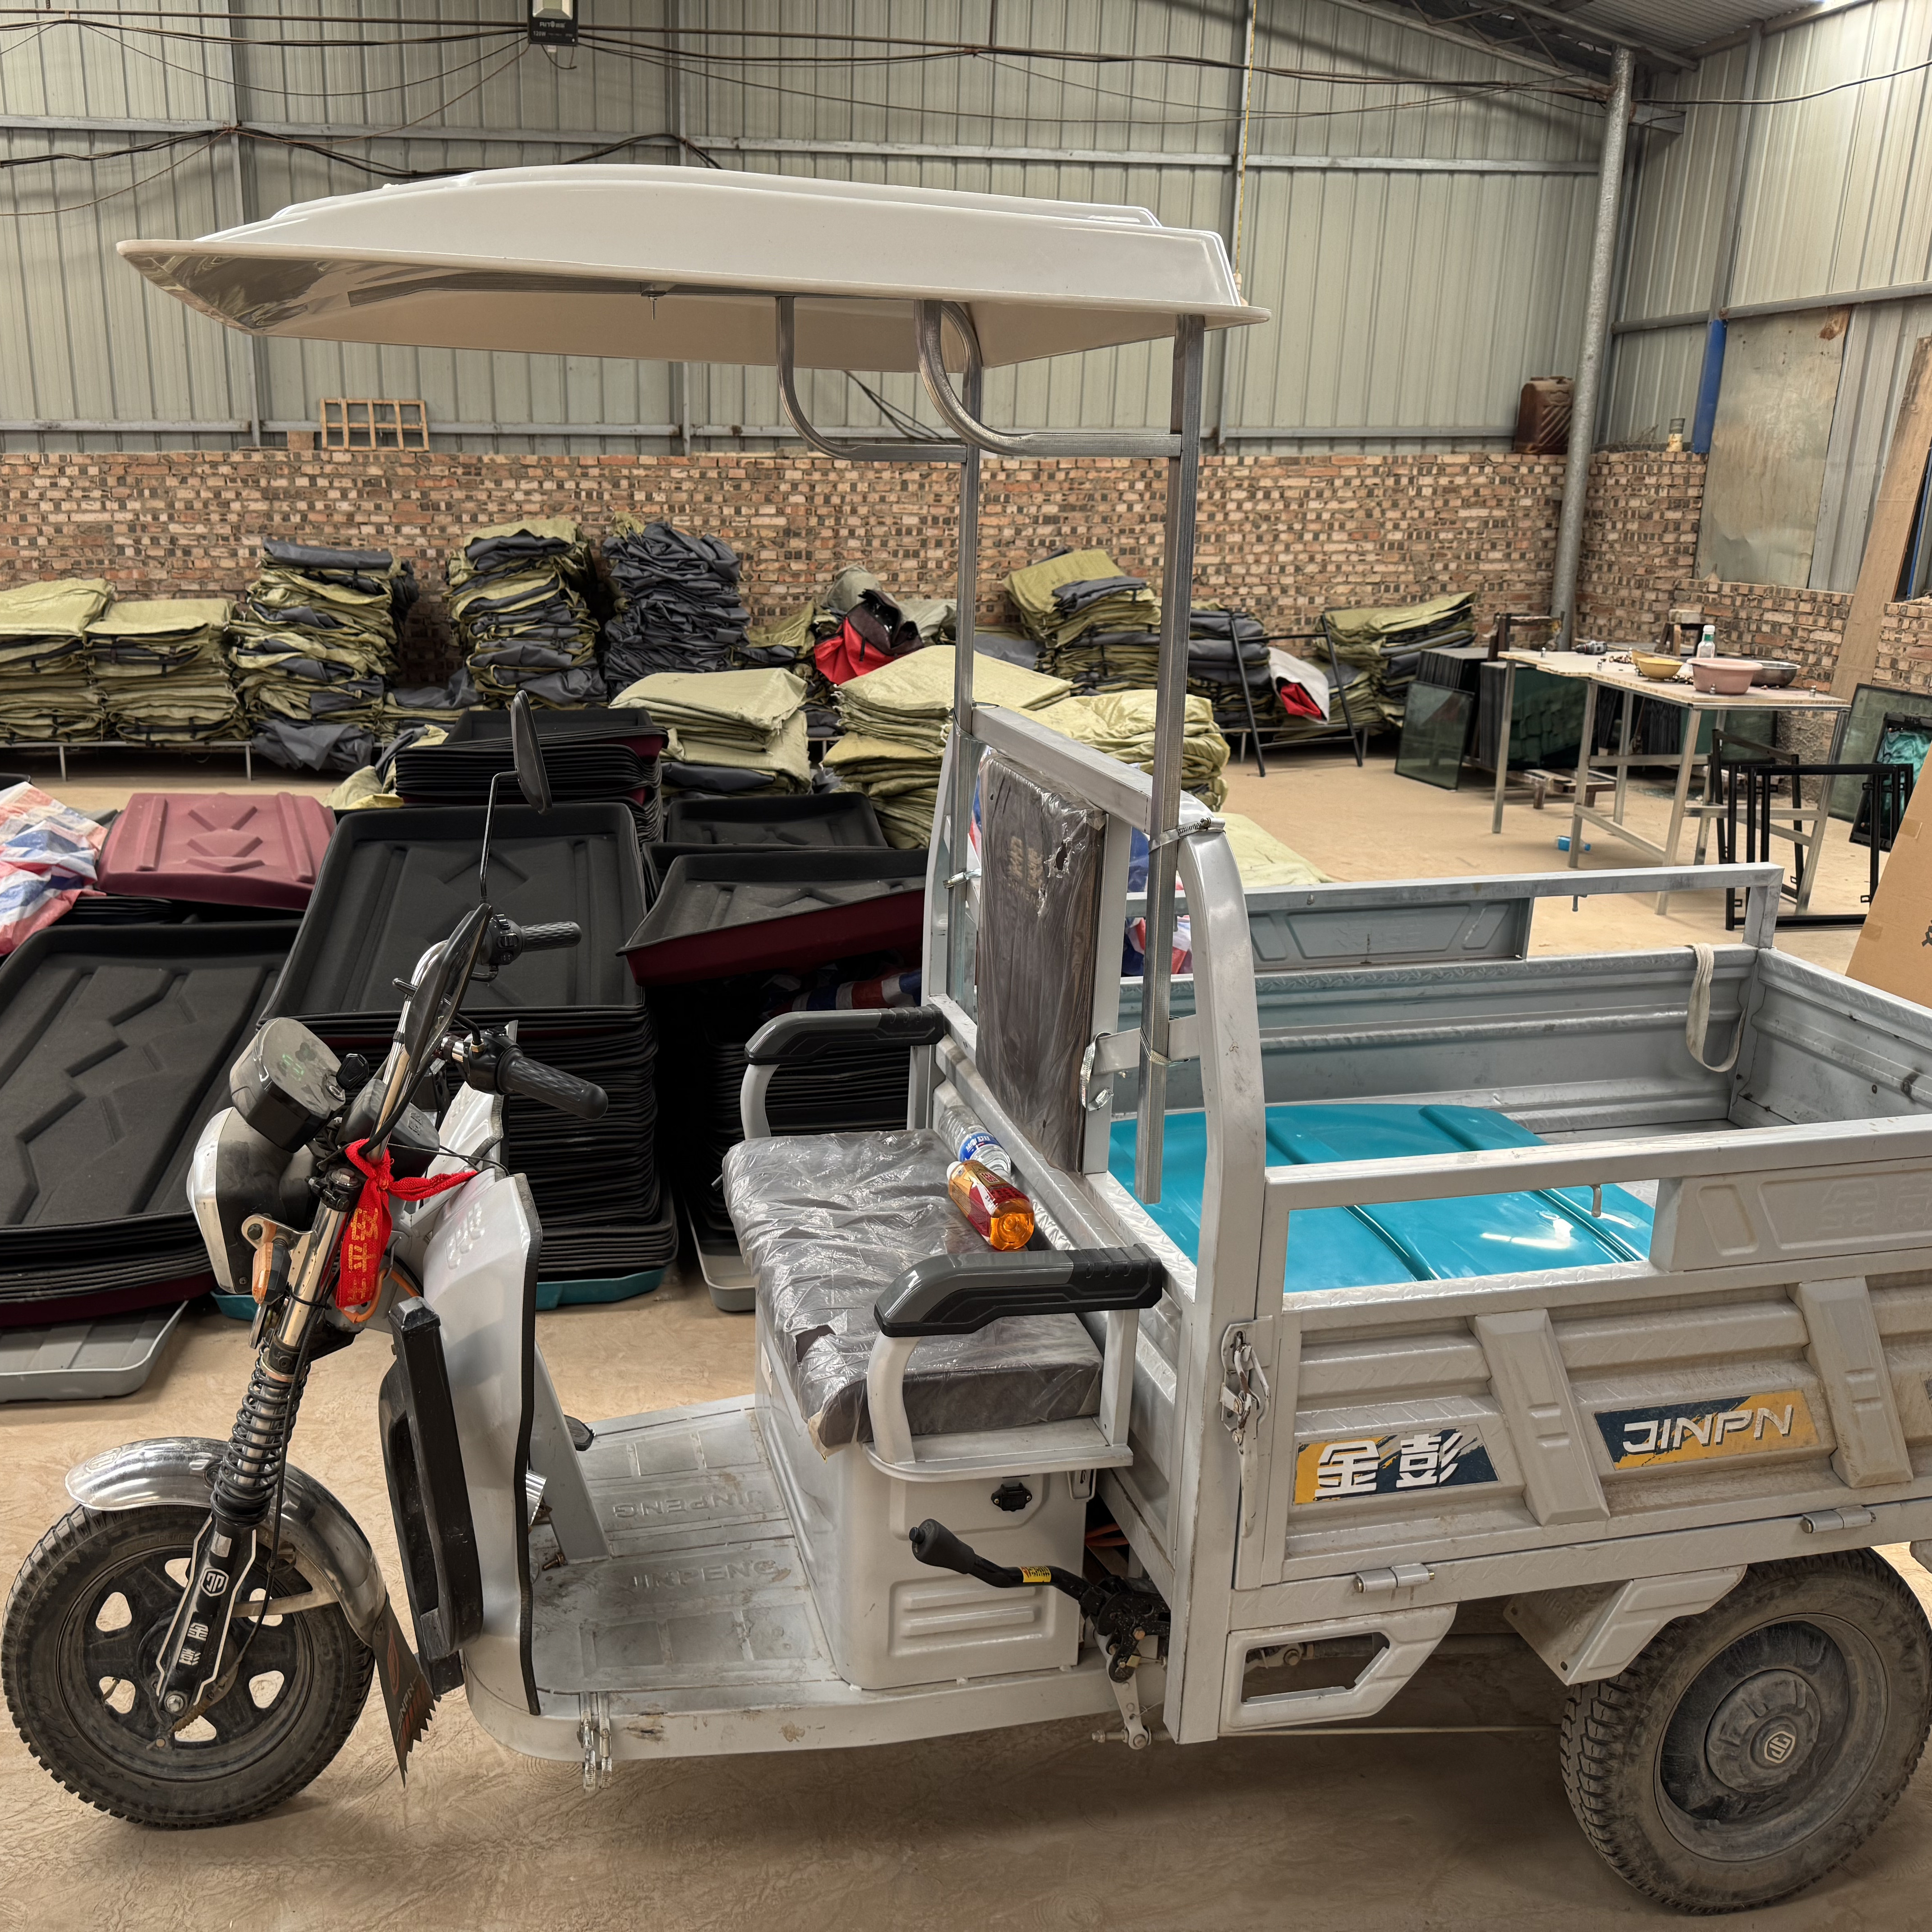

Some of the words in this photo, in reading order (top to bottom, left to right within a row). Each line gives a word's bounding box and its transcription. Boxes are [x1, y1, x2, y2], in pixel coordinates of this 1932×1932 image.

[1622, 1404, 1794, 1455] JINPN
[1314, 1429, 1463, 1500] 金彭
[613, 1490, 762, 1519] JINPENG
[178, 1622, 209, 1666] 金彭
